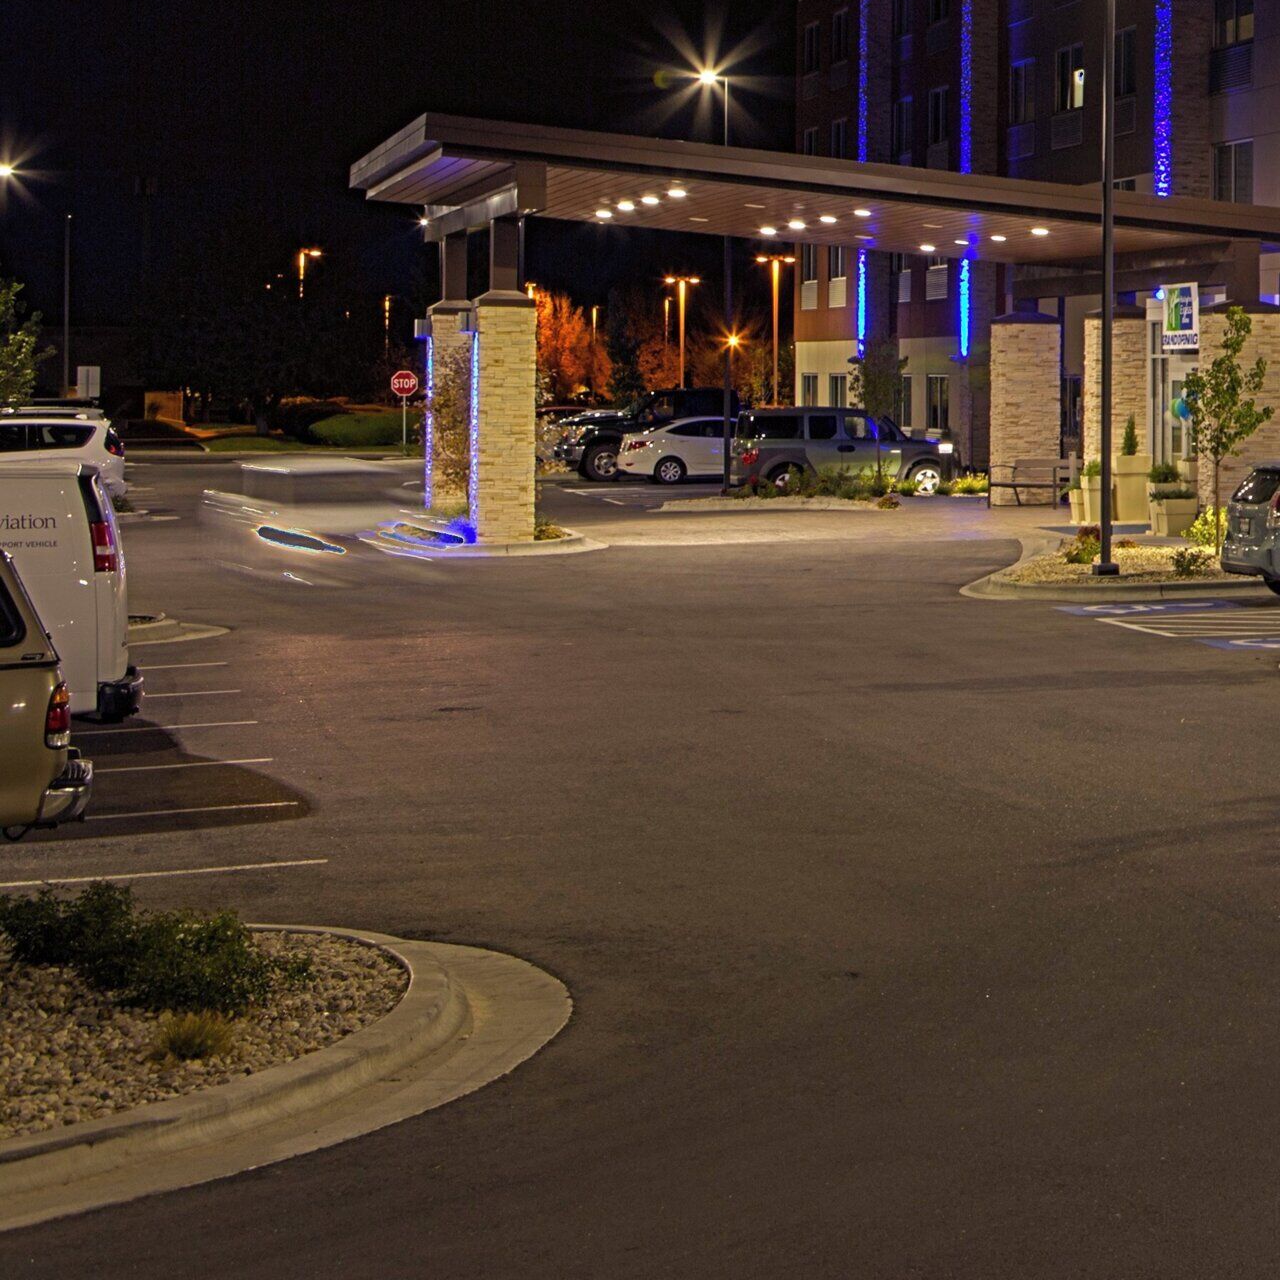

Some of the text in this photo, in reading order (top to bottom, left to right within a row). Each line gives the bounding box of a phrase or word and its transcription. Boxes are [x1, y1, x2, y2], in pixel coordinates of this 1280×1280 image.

[393, 378, 416, 389] STOP
[0, 540, 58, 548] PORT VEHICLE
